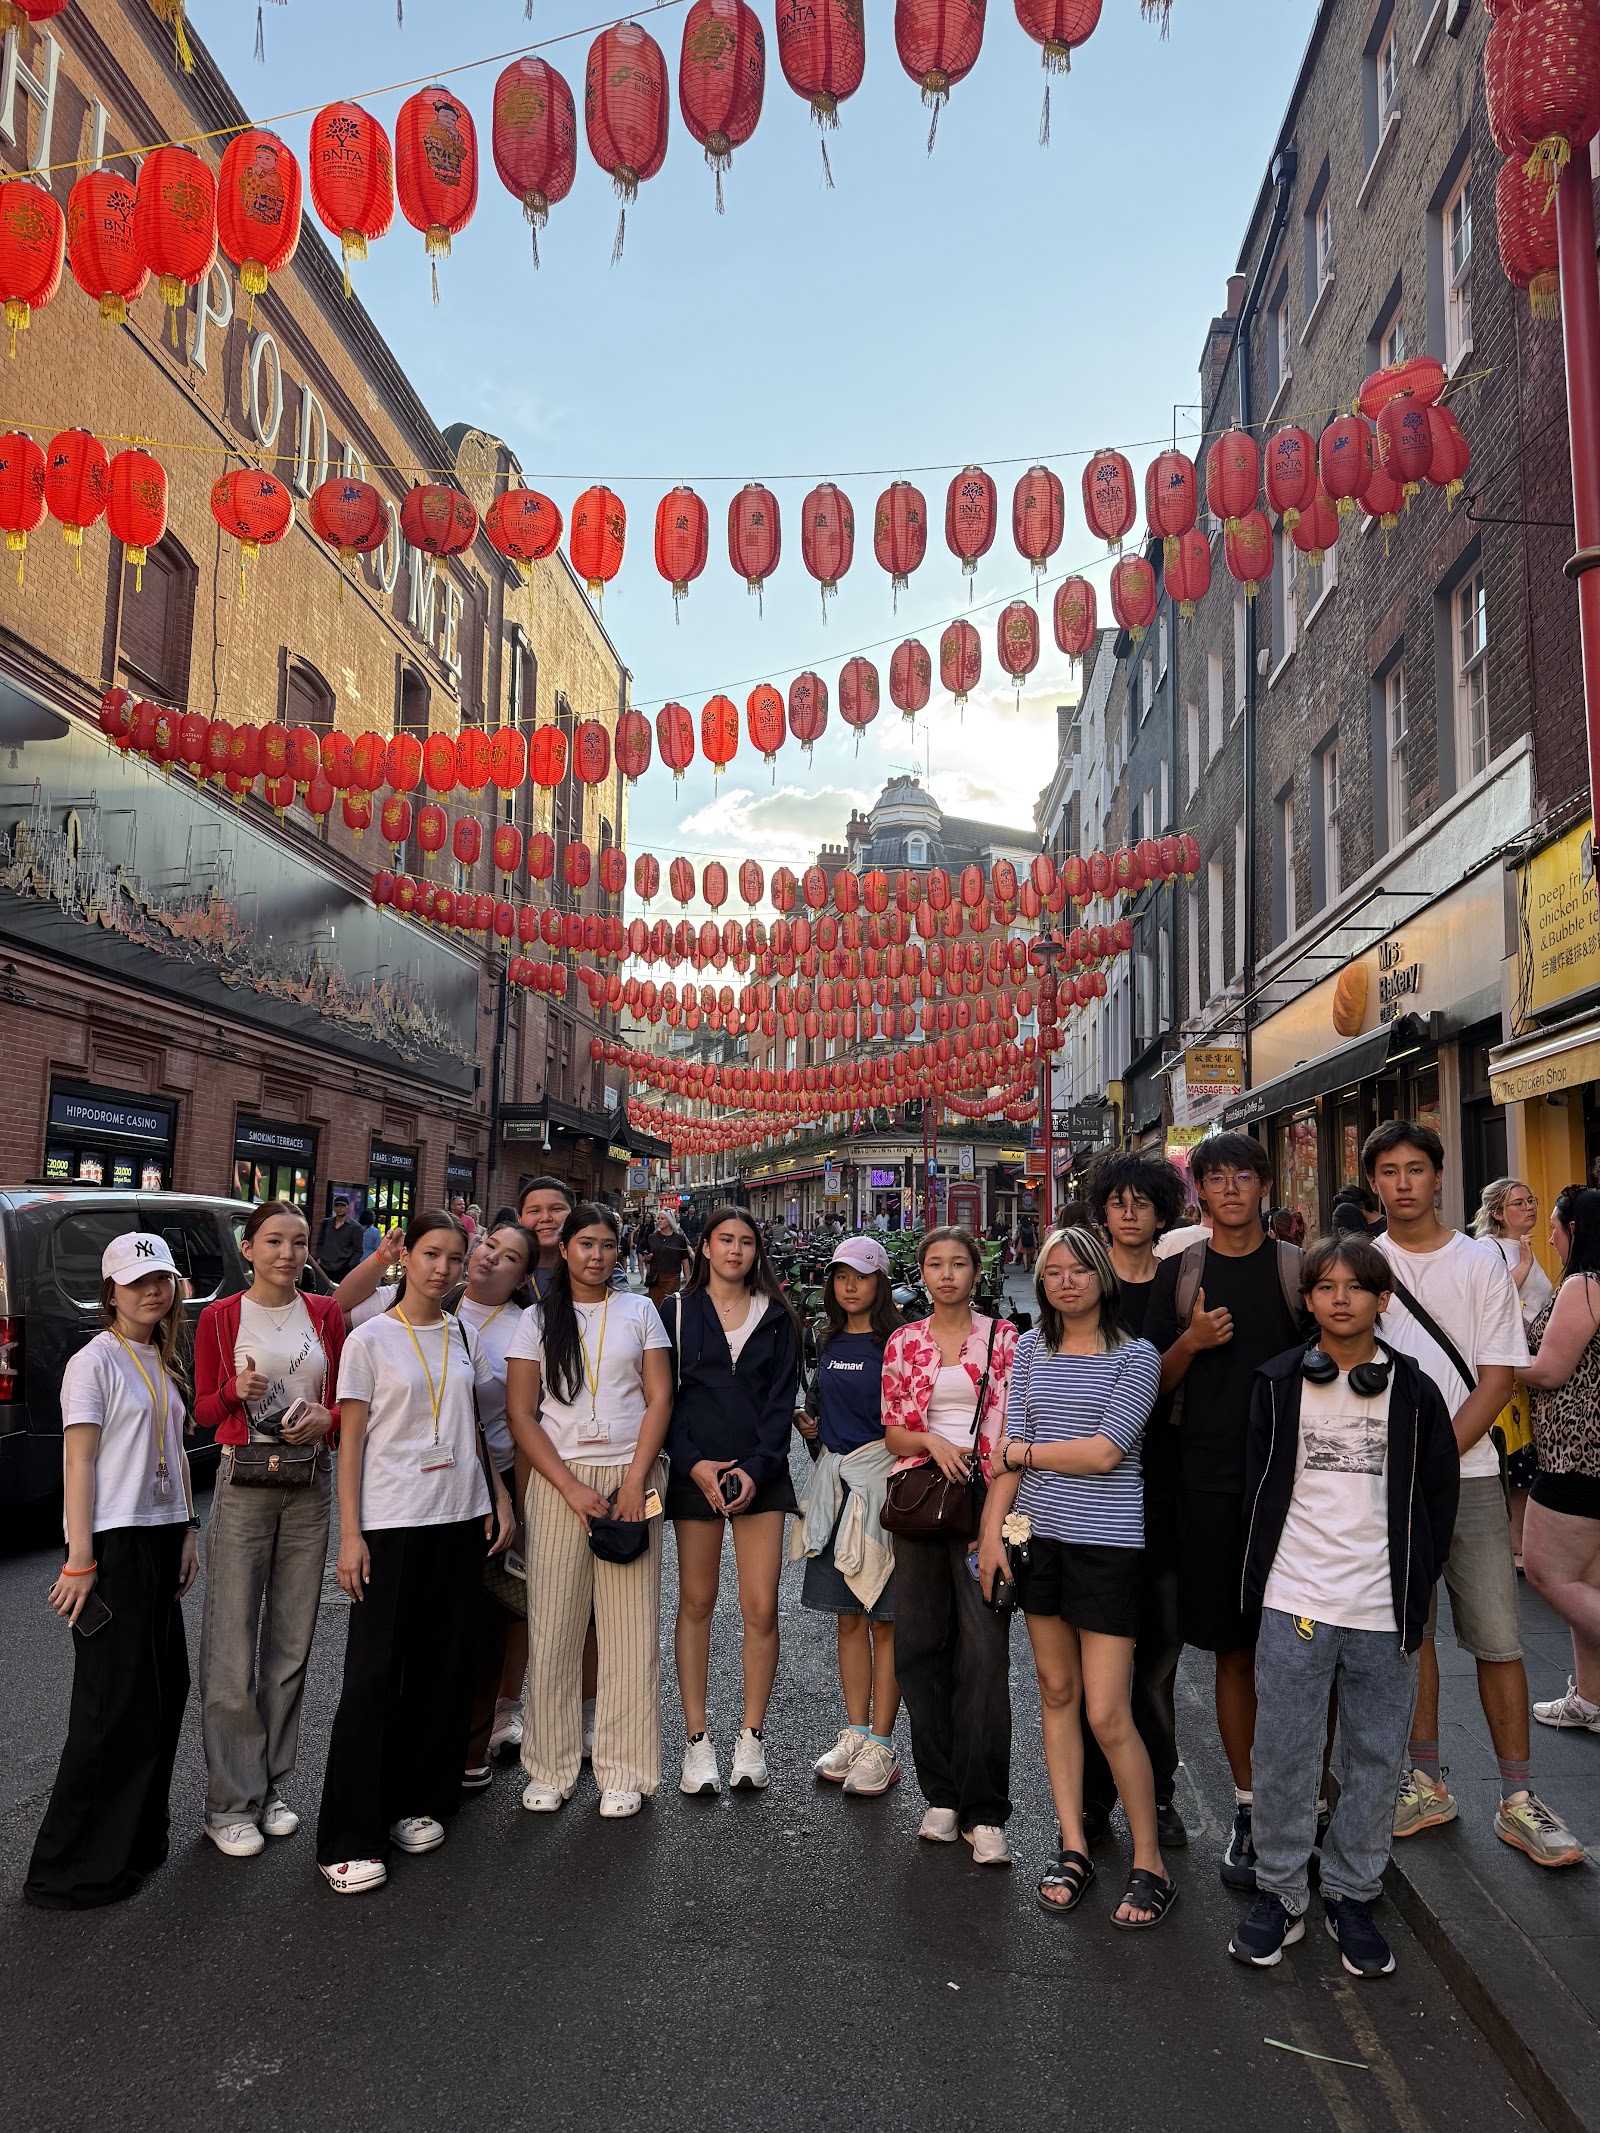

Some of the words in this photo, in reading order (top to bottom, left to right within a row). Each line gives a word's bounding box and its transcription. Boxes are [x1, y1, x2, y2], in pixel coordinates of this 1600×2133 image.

[781, 6, 816, 33] BNTA
[323, 148, 363, 164] BNTA
[104, 219, 134, 237] BNT
[1402, 434, 1427, 445] BNTA
[1275, 459, 1302, 471] BNTA
[1096, 486, 1123, 499] BNTA
[959, 504, 986, 514] BNTA
[760, 716, 780, 724] BNTA
[1538, 883, 1565, 909] Deep
[1568, 867, 1581, 890] fri
[1539, 898, 1579, 930] chicken
[1582, 887, 1598, 905] bre
[1540, 915, 1585, 951] &Bubble
[1589, 909, 1599, 925] te
[1378, 941, 1401, 971] Mrs
[1379, 963, 1420, 1004] Bakery
[1517, 1074, 1545, 1093] Chicken
[1546, 1067, 1567, 1085] Shop
[1187, 1085, 1223, 1094] MASSAGE
[66, 1104, 125, 1125] HIPPODROME
[126, 1115, 157, 1130] CASINO
[248, 1131, 276, 1145] SMOKING
[276, 1135, 304, 1149] TERRACES
[376, 1153, 387, 1162] BARS
[391, 1155, 403, 1164] OPEN
[134, 1239, 156, 1258] NY
[254, 1378, 285, 1423] ativity
